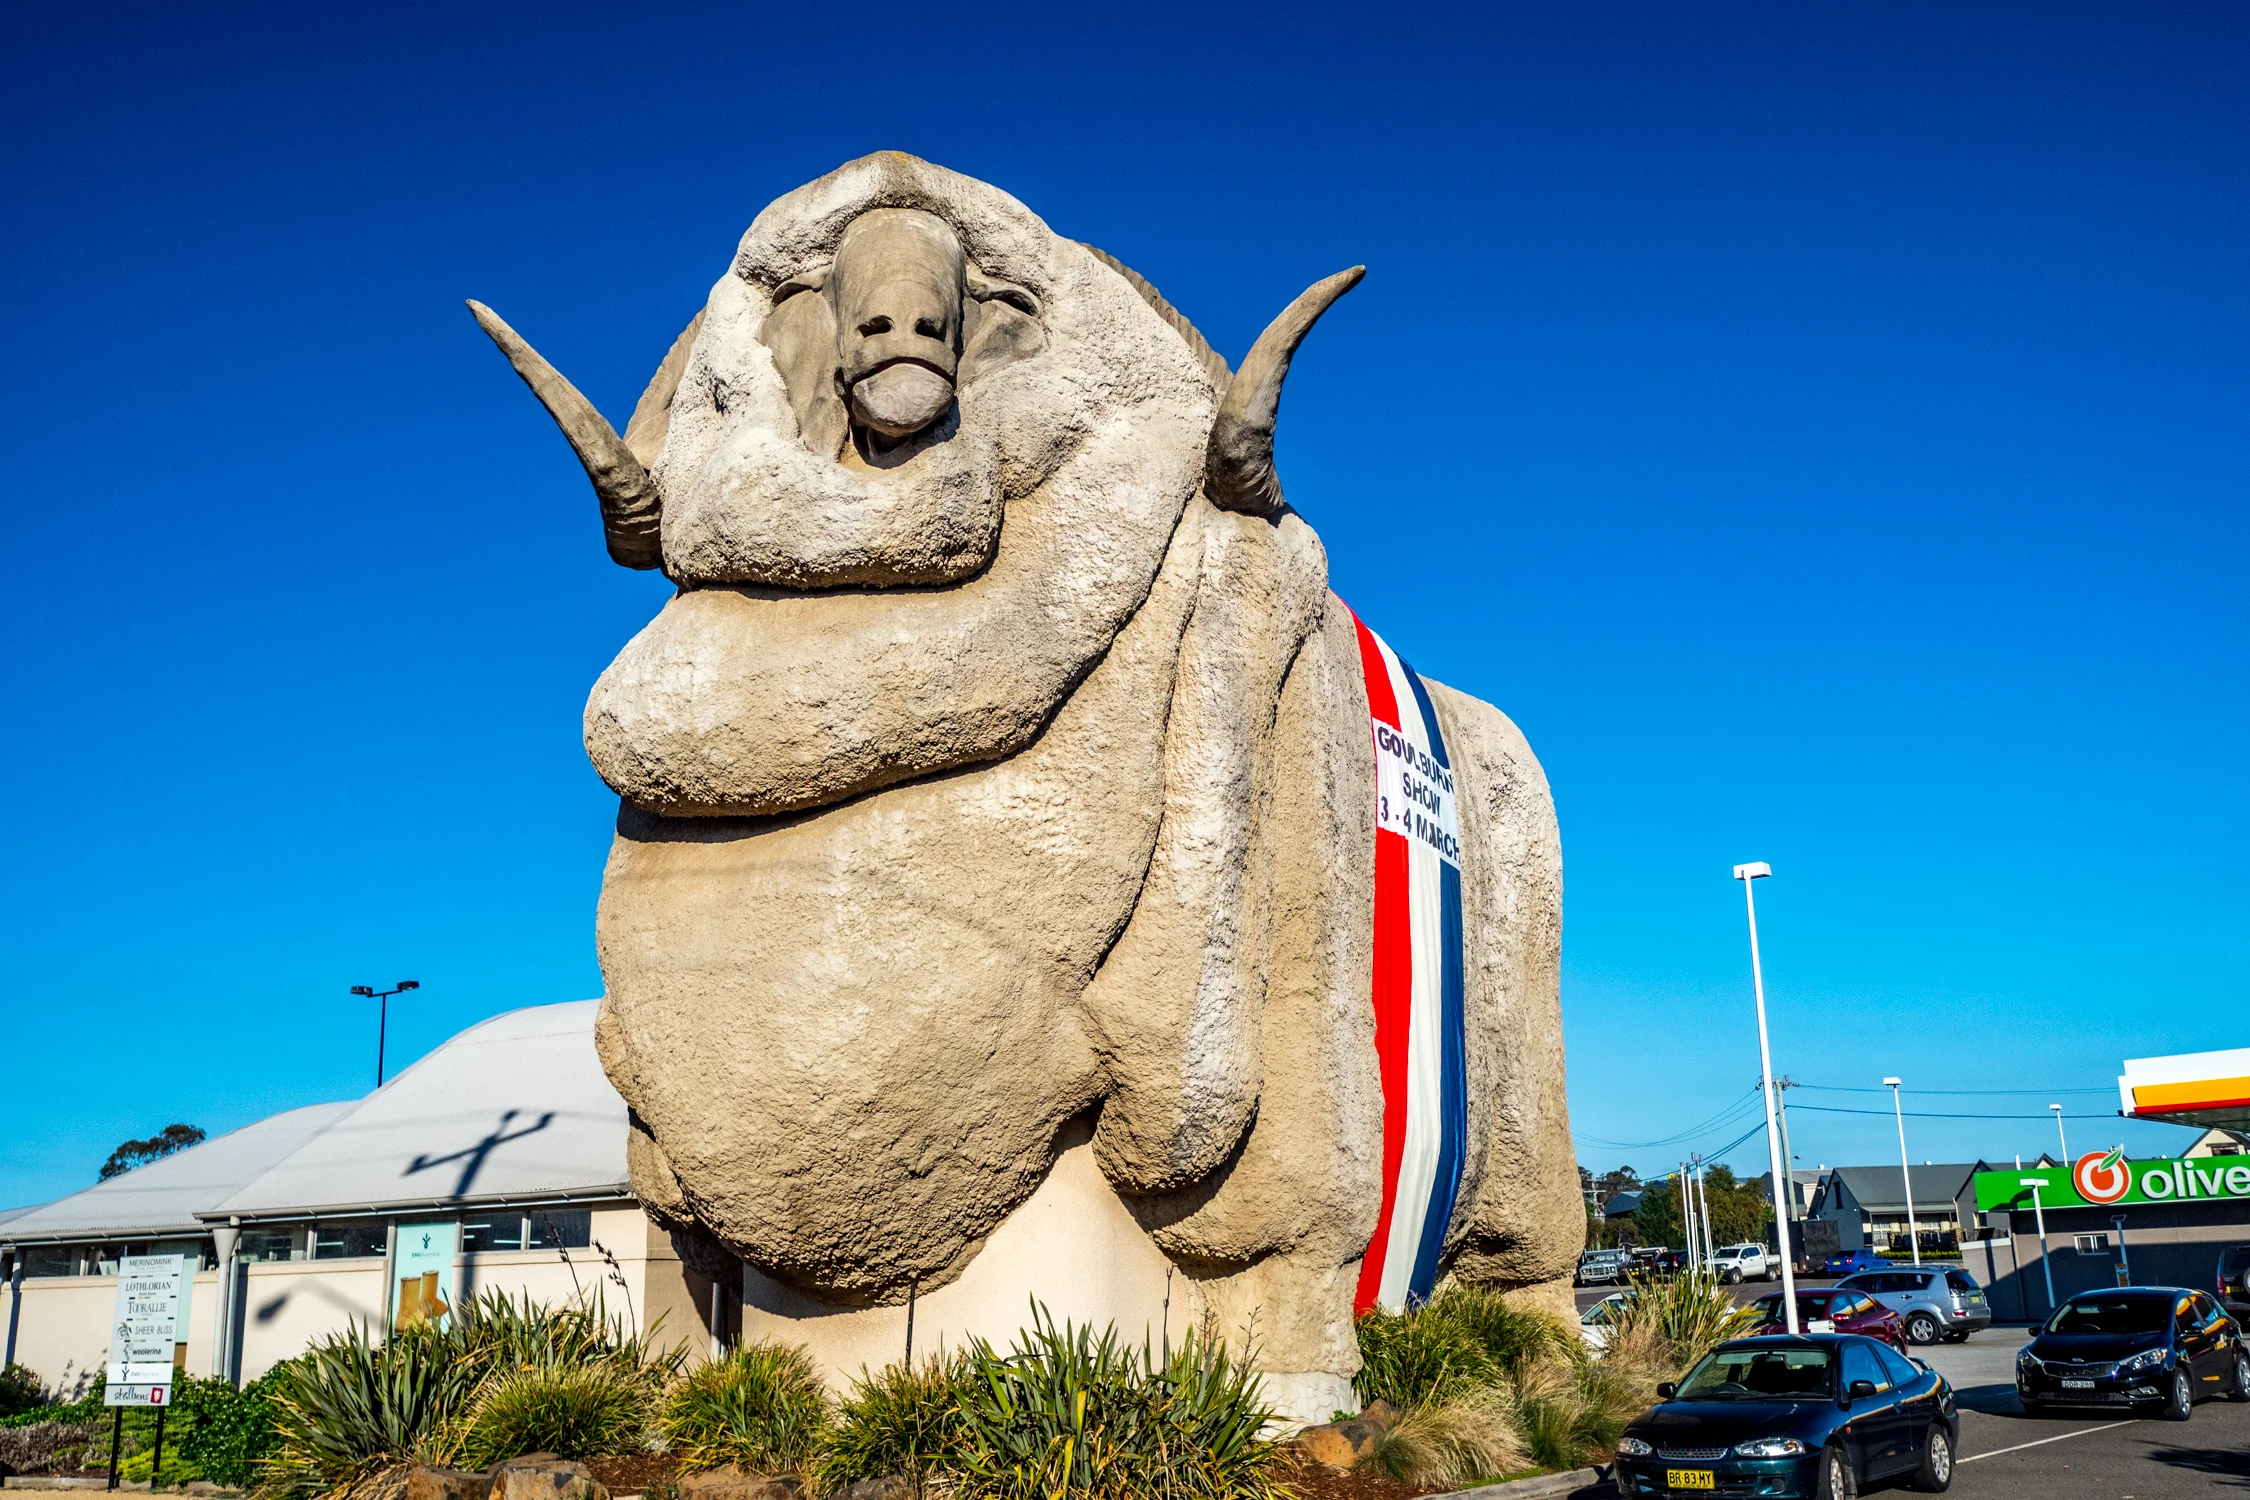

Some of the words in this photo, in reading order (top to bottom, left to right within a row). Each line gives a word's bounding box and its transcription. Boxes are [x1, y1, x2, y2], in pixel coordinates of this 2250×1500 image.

[1377, 726, 1454, 795] GOULBURN
[1402, 772, 1441, 818] SHOW
[1380, 796, 1389, 822] 3
[1403, 808, 1412, 833] 4
[1416, 813, 1461, 864] MARCH
[2141, 1160, 2250, 1199] olive
[129, 1258, 172, 1267] MERINOMINK
[125, 1281, 171, 1292] LOTHLORIAN
[134, 1325, 155, 1335] SHEER
[156, 1325, 173, 1335] BLISS
[132, 1347, 161, 1356] woolerina
